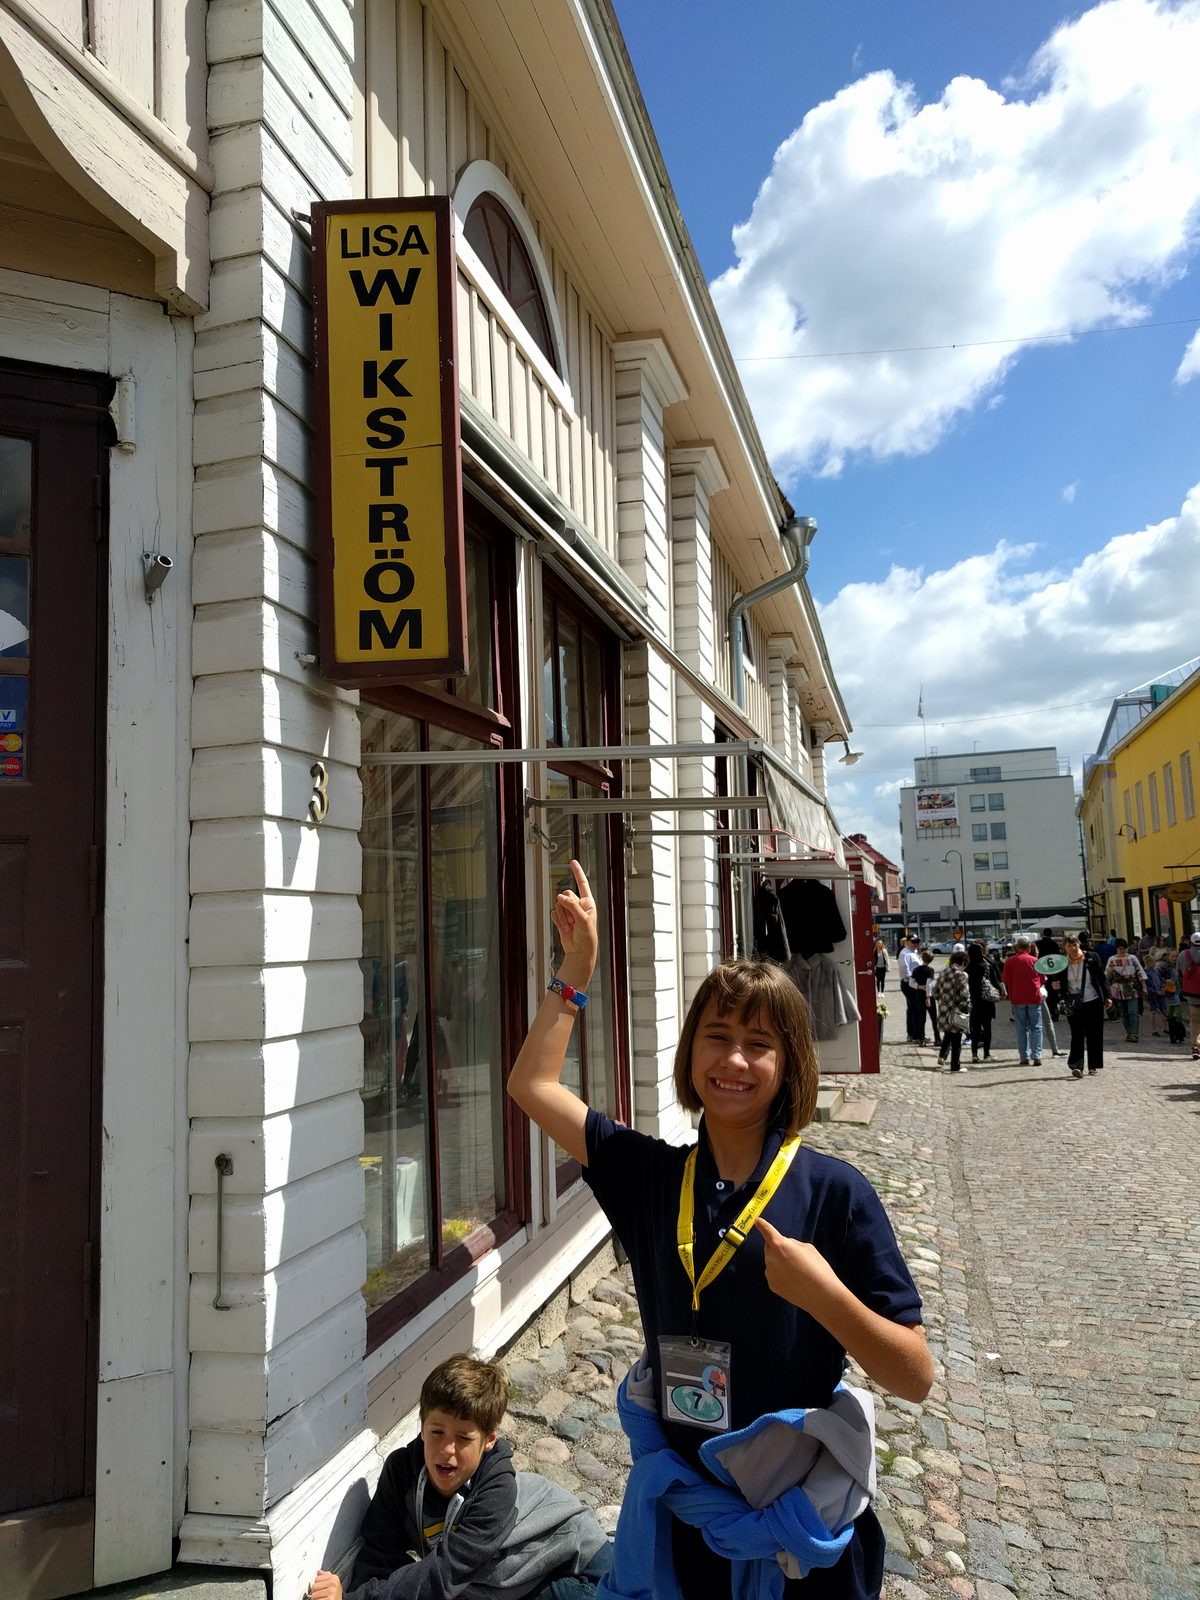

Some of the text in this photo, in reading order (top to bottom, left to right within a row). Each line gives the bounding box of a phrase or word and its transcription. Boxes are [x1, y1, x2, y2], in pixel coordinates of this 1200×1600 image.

[340, 224, 430, 260] LISA
[347, 266, 423, 651] WIKSTRÖM
[308, 761, 330, 823] 3
[1047, 957, 1055, 968] 6
[737, 1213, 753, 1230] Disney
[692, 1391, 703, 1410] 7
